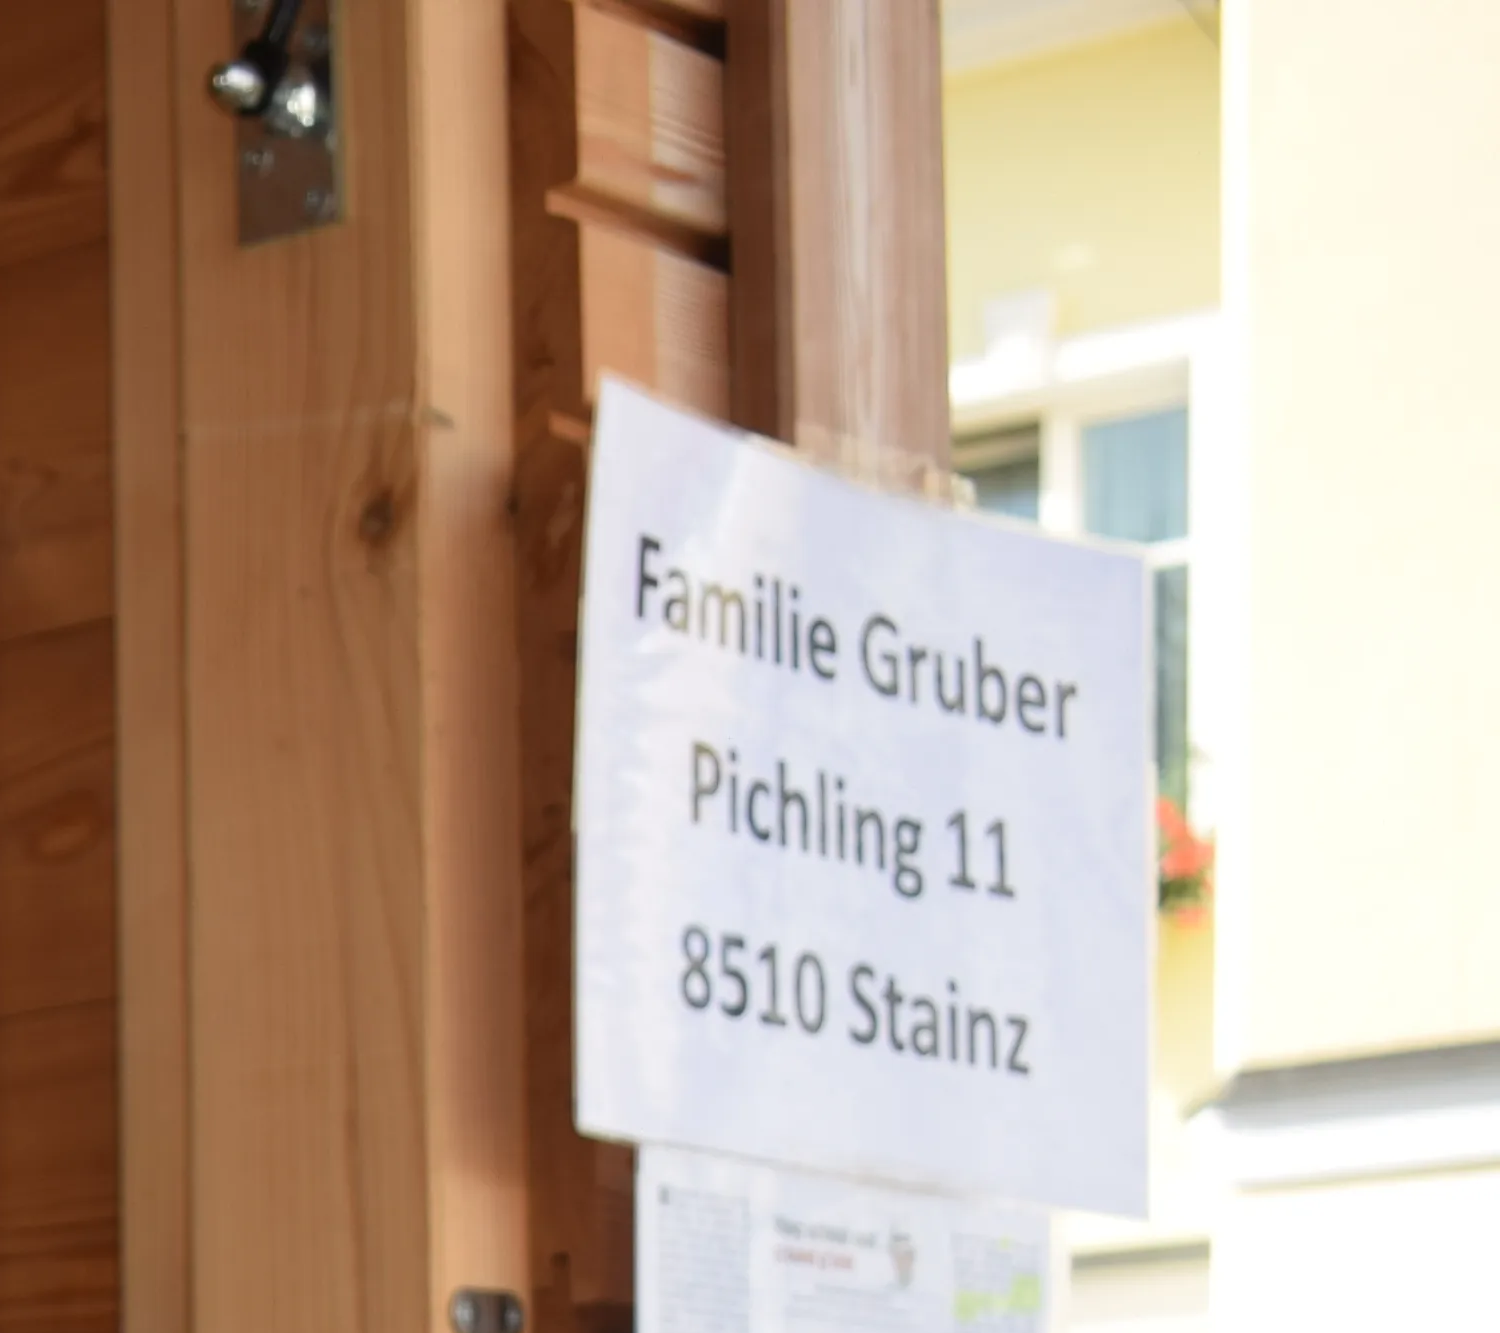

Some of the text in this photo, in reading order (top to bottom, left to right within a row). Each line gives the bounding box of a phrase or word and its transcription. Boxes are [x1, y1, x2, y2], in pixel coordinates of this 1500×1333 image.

[635, 534, 1078, 740] Familie Gruber
[690, 740, 1017, 899] Pichling 11
[680, 924, 1030, 1076] 8510 Stainz
